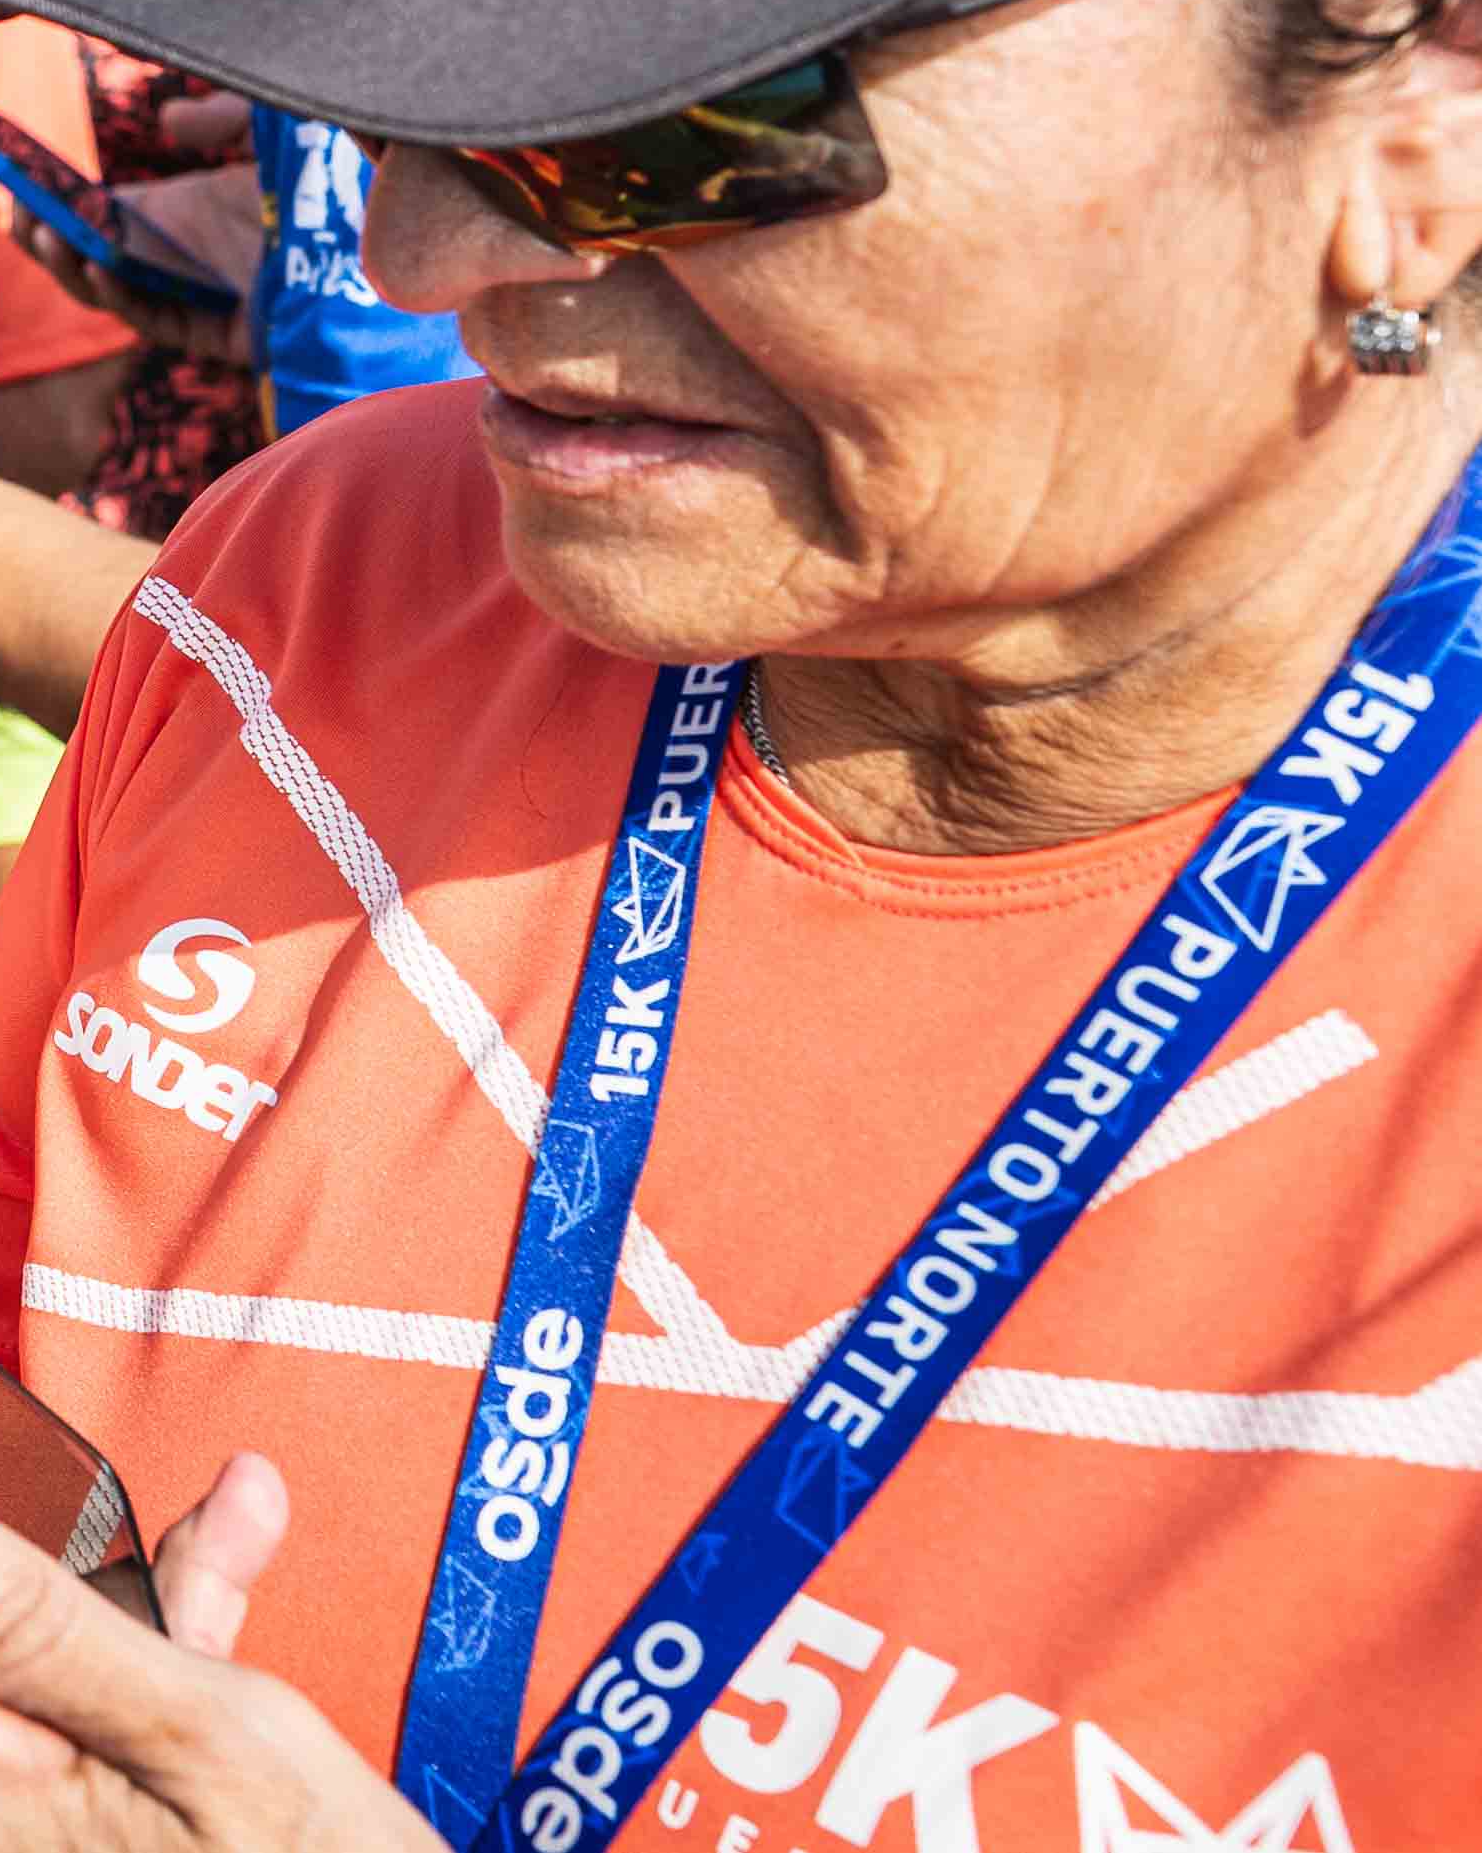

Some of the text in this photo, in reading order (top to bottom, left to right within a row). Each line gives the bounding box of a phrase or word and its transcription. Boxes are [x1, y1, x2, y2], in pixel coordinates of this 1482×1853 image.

[588, 975, 670, 1103] 15K
[804, 661, 1436, 1449] 15K PUERTO NORTE
[476, 1307, 584, 1561] osde
[520, 1619, 705, 1853] osde
